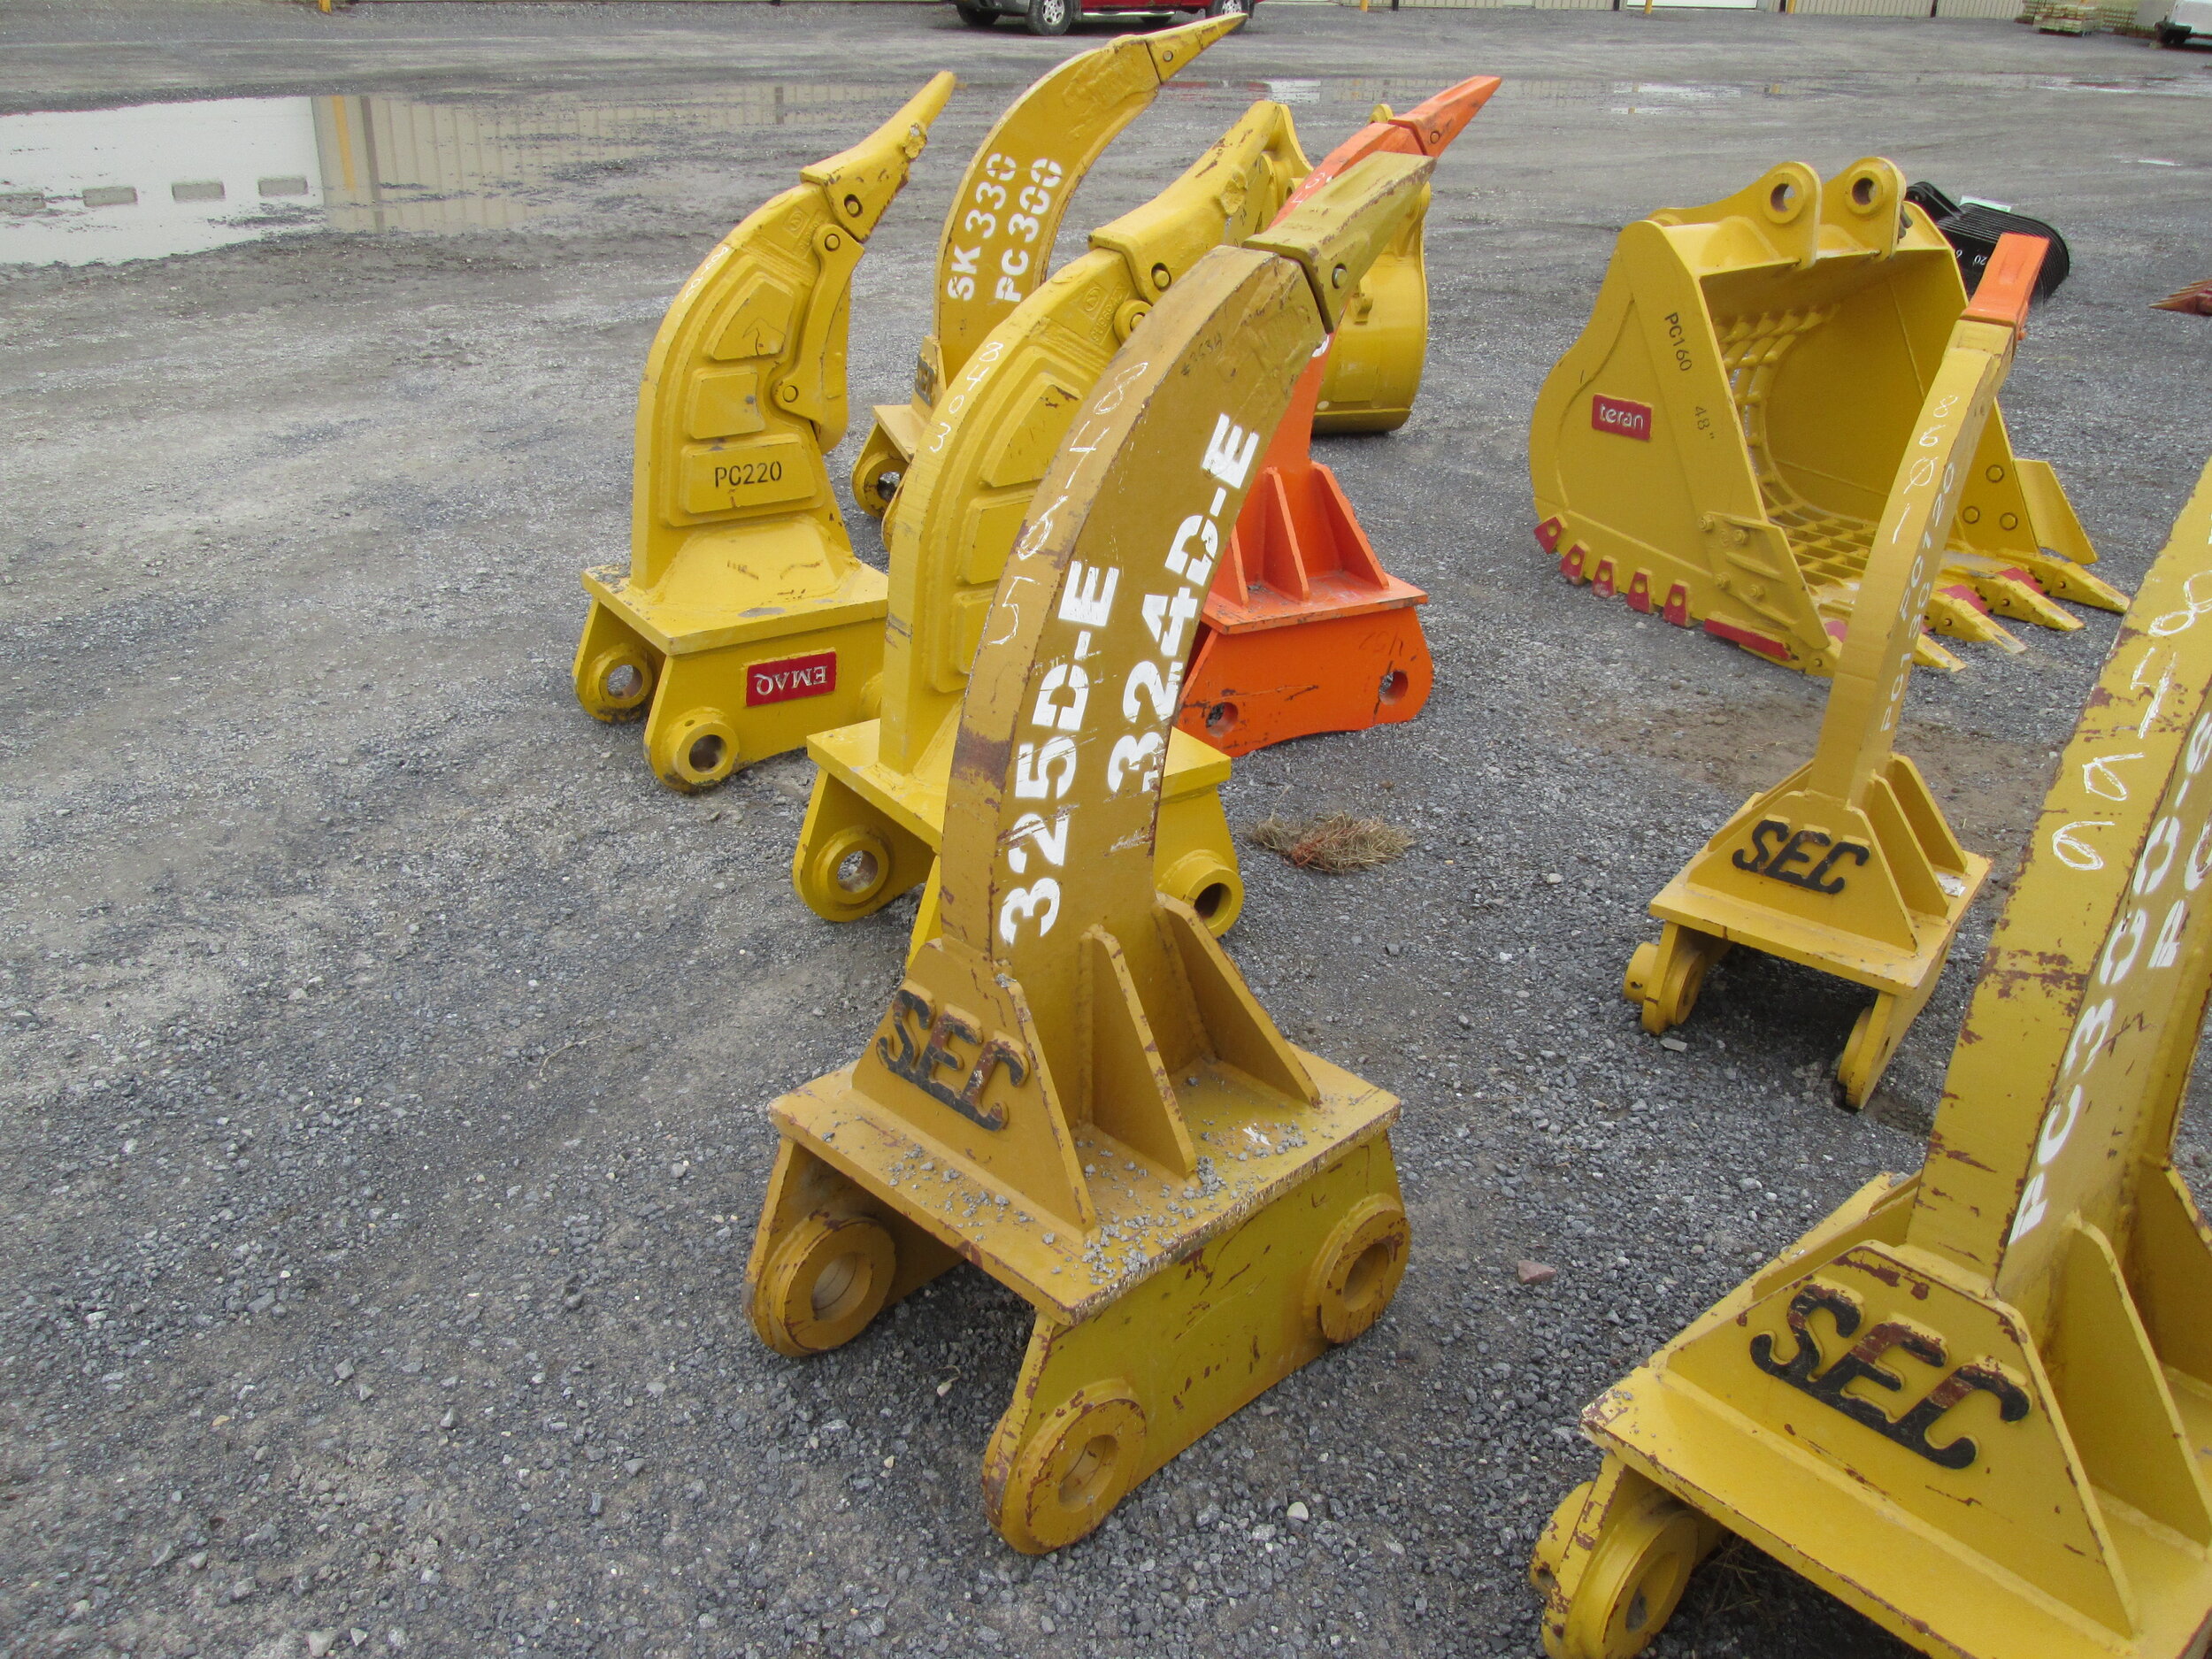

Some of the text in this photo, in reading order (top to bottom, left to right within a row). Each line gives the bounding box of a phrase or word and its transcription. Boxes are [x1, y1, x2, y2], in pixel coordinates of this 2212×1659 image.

[965, 152, 1017, 240] 330
[1008, 157, 1063, 243] 300
[1664, 311, 1693, 373] PC160
[1599, 403, 1645, 431] teran
[714, 460, 782, 488] PC220
[1107, 412, 1260, 793] 324D-E
[753, 664, 828, 696] EMAQ
[1000, 559, 1119, 945] 325D-E
[1732, 818, 1870, 895] SEC
[875, 987, 1029, 1133] SEC
[1749, 1282, 2032, 1471] SEC
